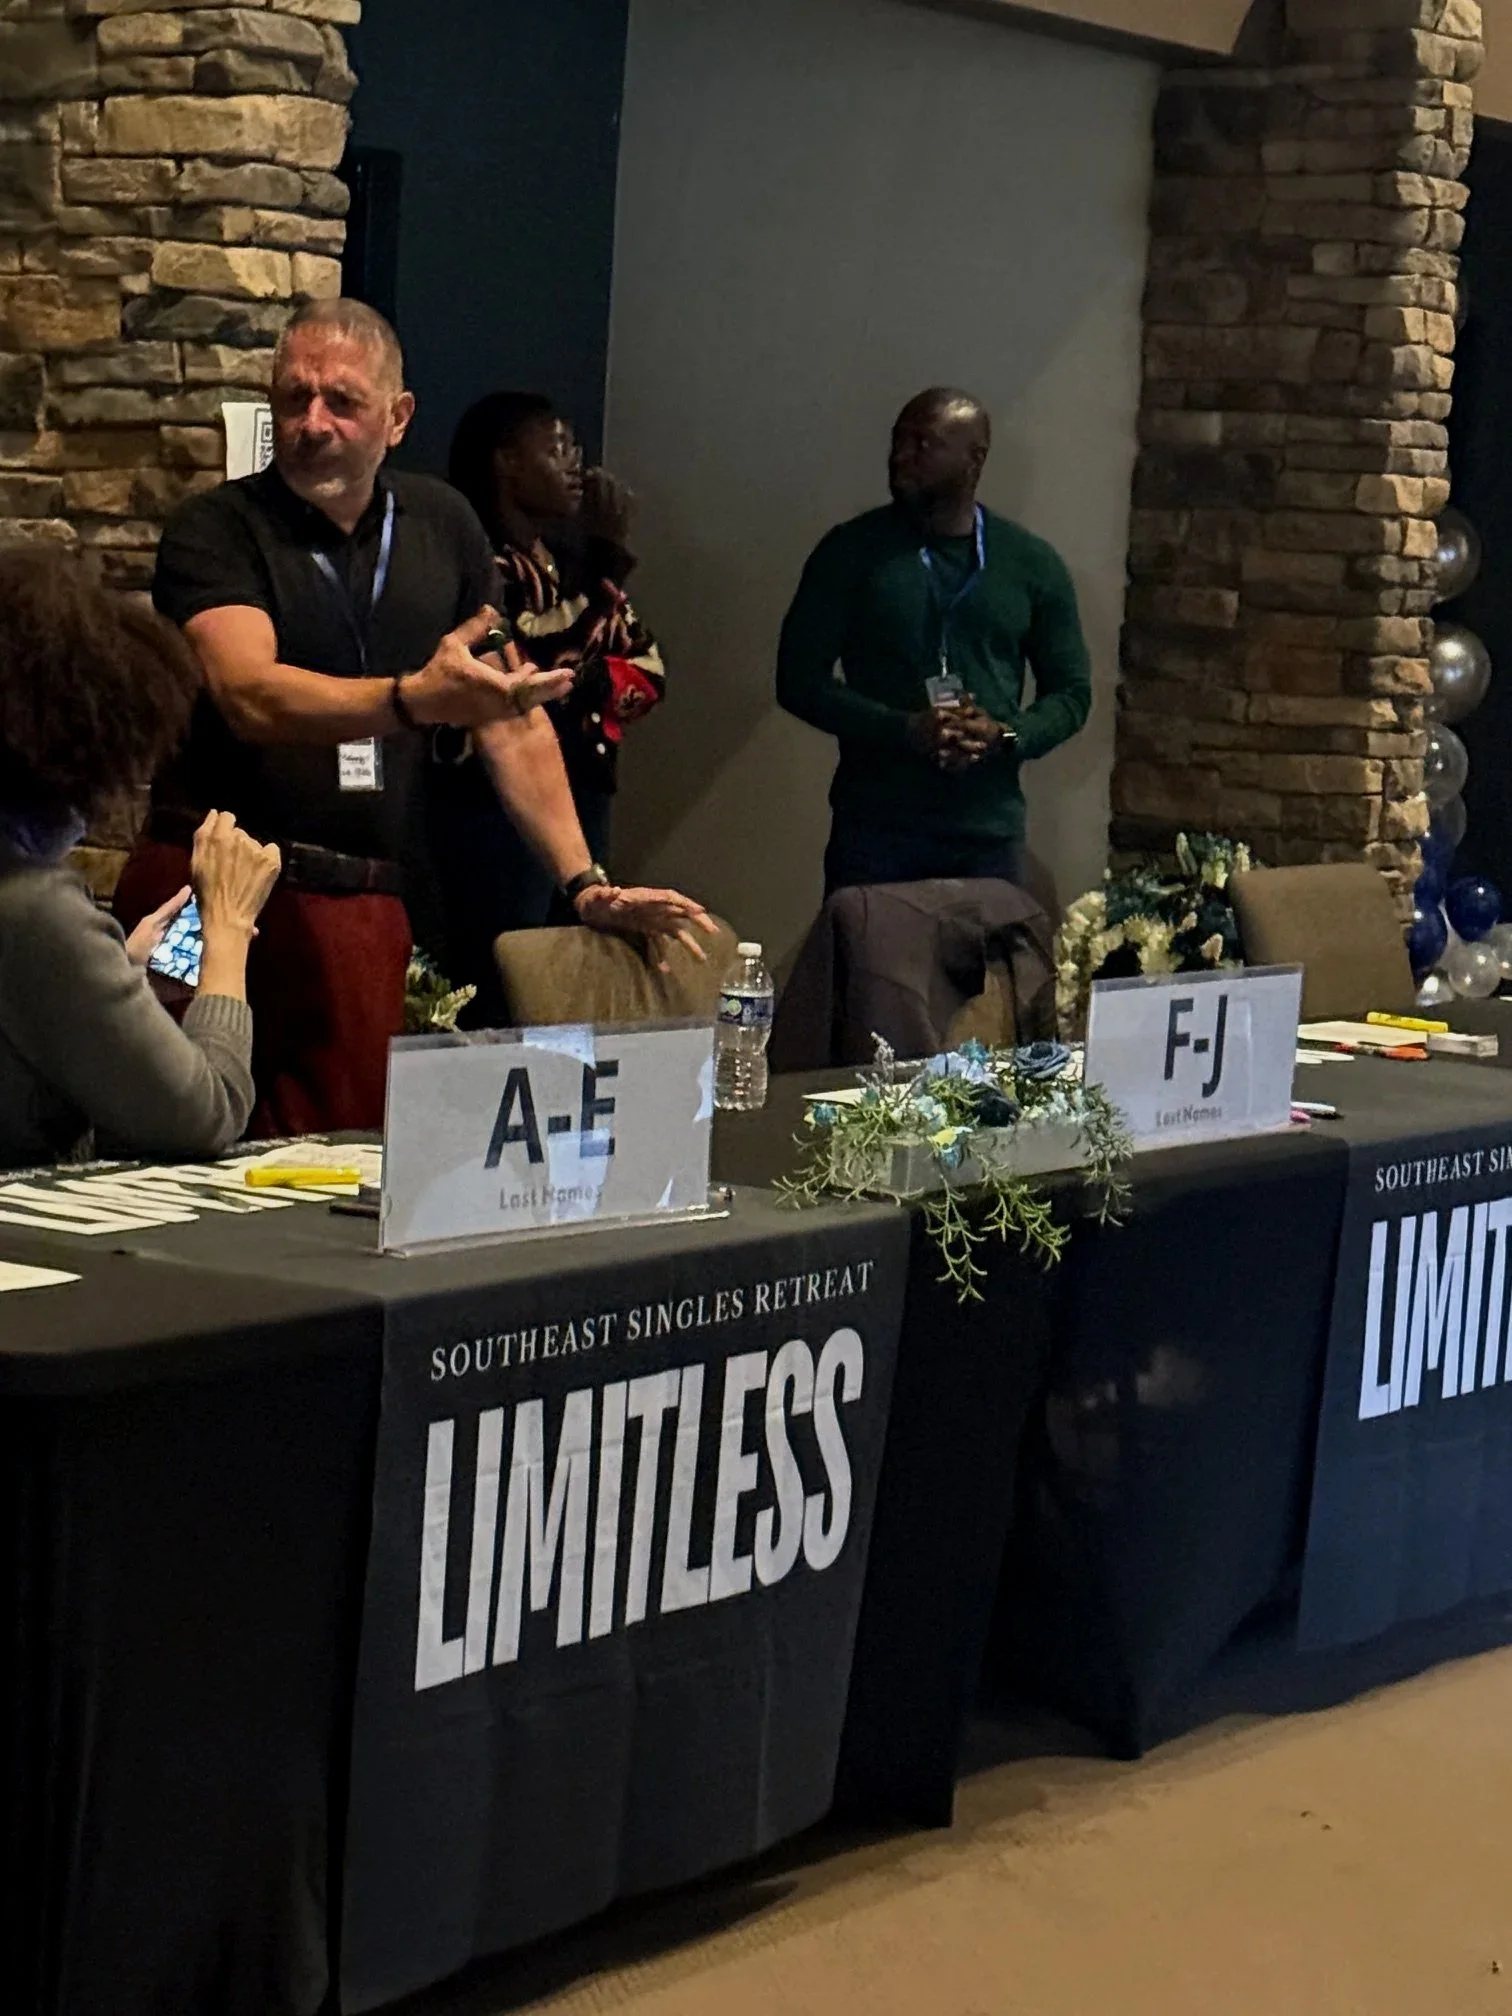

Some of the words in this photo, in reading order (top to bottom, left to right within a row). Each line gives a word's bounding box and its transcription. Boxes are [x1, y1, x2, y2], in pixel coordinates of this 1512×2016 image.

[1163, 994, 1228, 1099] F-J
[484, 1059, 620, 1169] A-E
[1156, 1109, 1181, 1127] Last
[1183, 1103, 1223, 1122] Names
[499, 1187, 538, 1210] Last
[541, 1184, 603, 1206] Names
[1375, 1150, 1485, 1193] SOUTHEAST
[430, 1314, 617, 1381] SOUTHEAST
[627, 1289, 744, 1341] SINGLES
[753, 1260, 875, 1316] RETREAT
[1358, 1197, 1512, 1421] LIMIT
[414, 1327, 864, 1692] LIMITLESS
